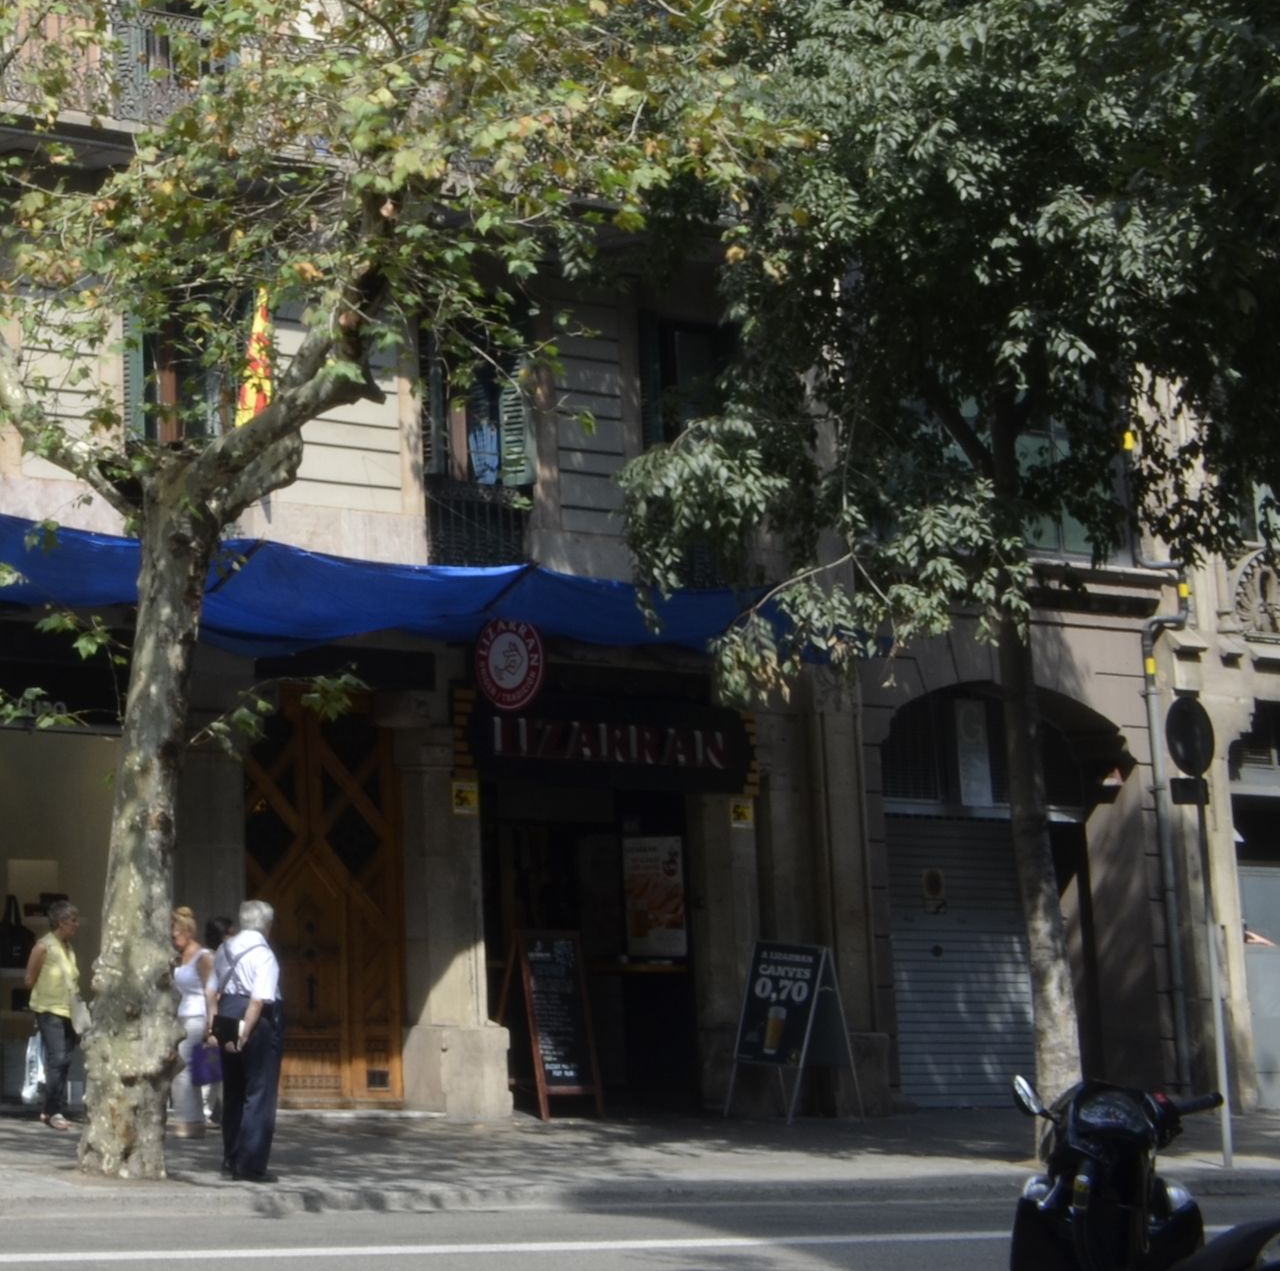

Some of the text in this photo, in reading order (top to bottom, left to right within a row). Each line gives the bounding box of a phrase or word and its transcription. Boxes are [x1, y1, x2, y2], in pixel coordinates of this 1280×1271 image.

[479, 620, 540, 666] LIZARRAN
[493, 716, 730, 770] LIZARRAN
[759, 964, 811, 979] CANYES
[754, 977, 808, 1003] 0,70
